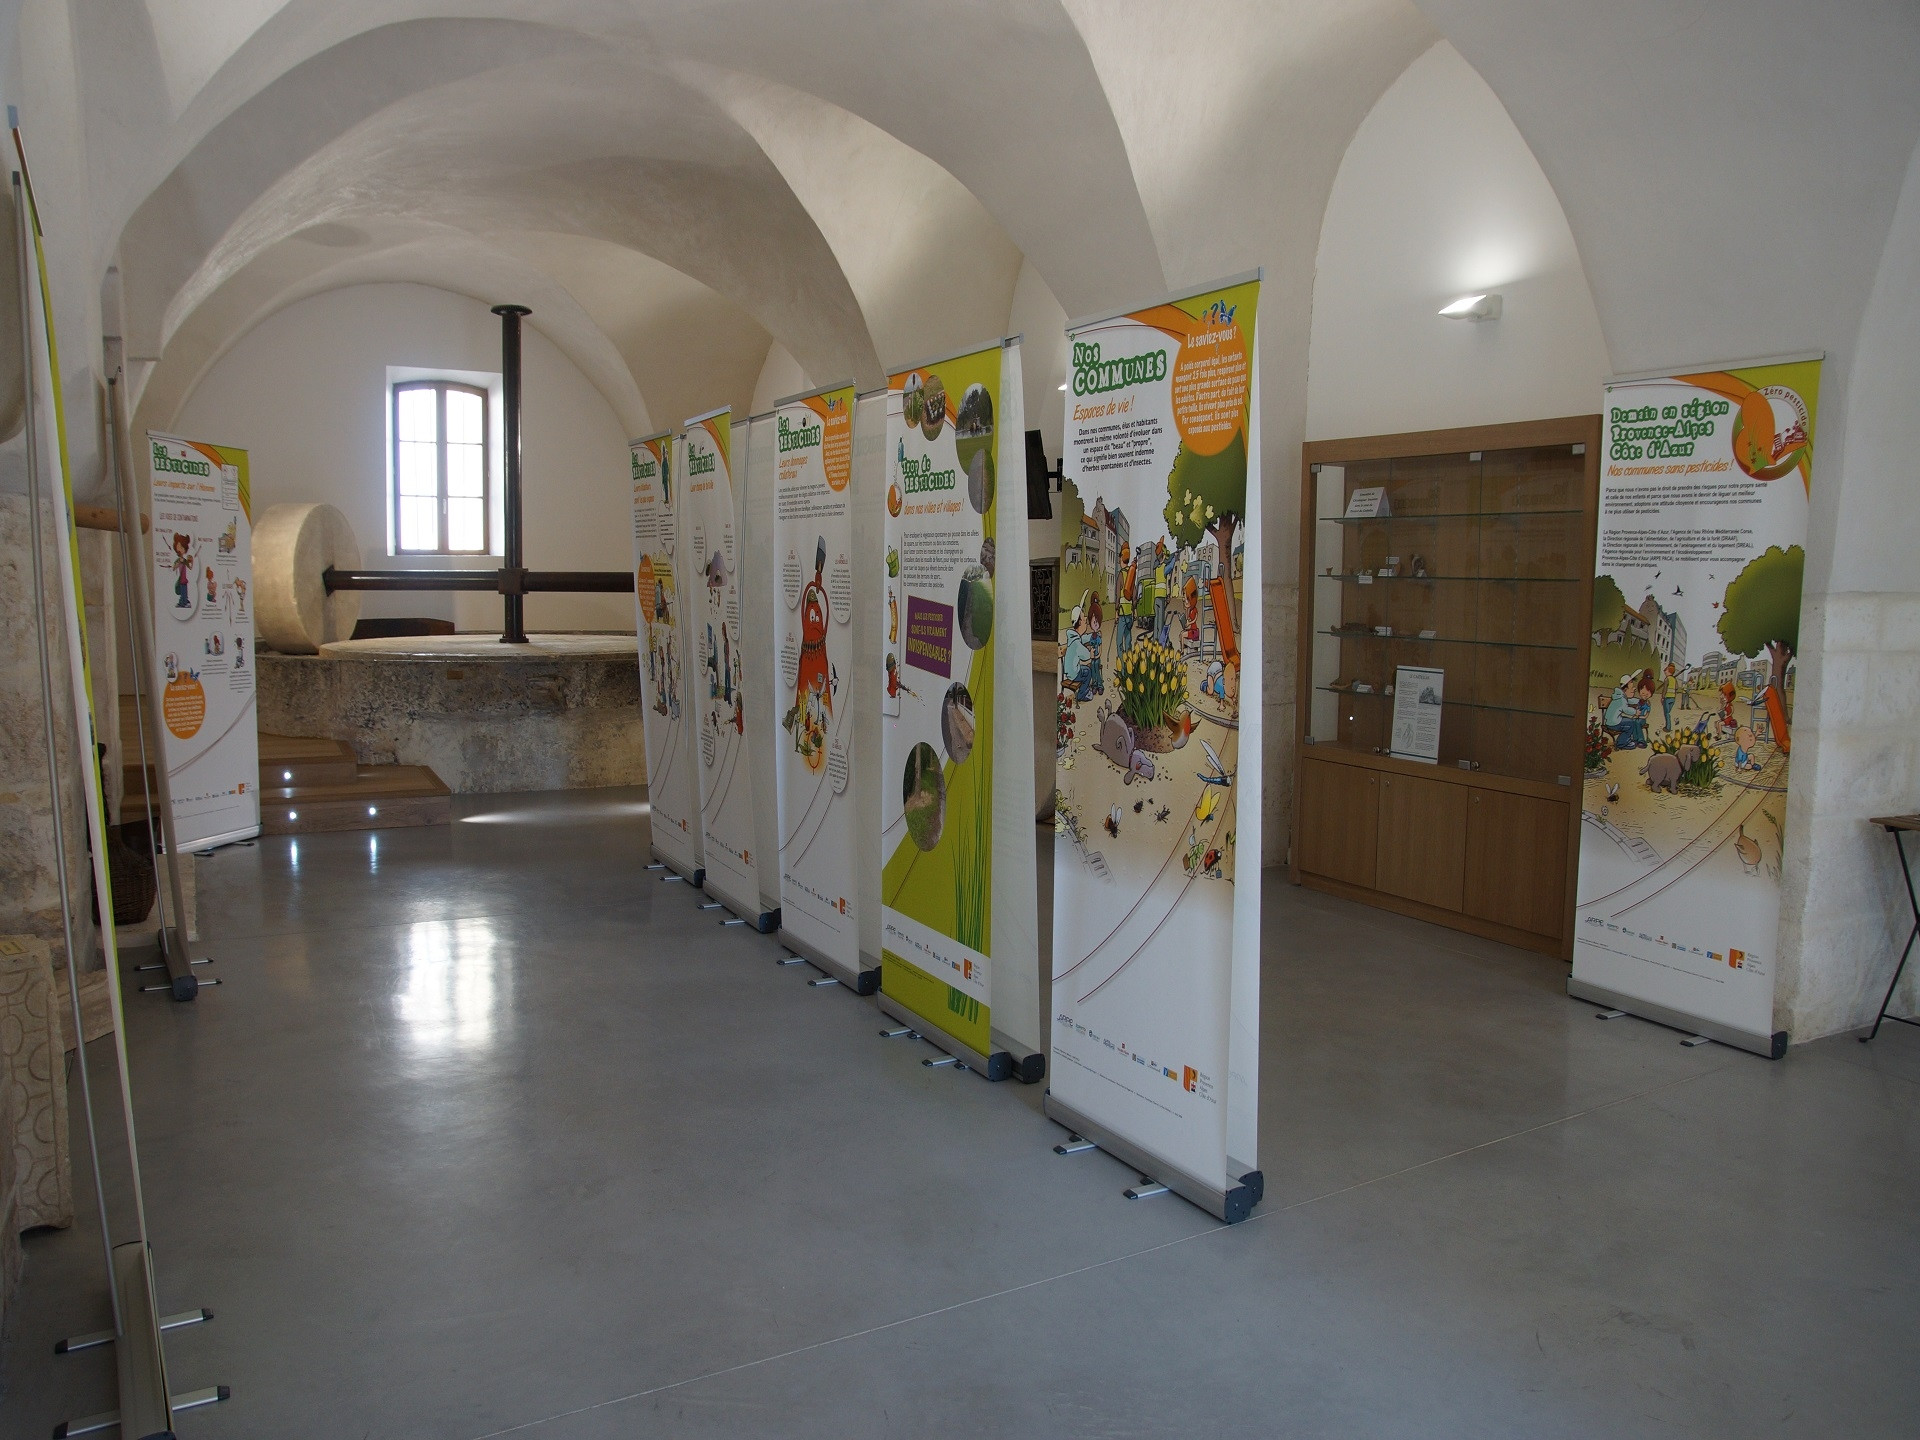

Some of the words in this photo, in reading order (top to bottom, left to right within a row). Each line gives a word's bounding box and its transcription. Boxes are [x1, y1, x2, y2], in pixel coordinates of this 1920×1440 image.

[1187, 333, 1194, 348] Le
[1195, 329, 1232, 346] saviez-vous
[1073, 341, 1099, 365] Nos
[1073, 351, 1165, 394] COMMUNES
[1073, 403, 1107, 423] Espaces
[1108, 398, 1117, 416] de
[1118, 398, 1129, 413] vie
[1130, 395, 1135, 411] !
[1611, 406, 1656, 422] Demain
[1662, 406, 1677, 418] en
[1682, 398, 1728, 419] région
[1763, 386, 1782, 395] Zéro
[1783, 391, 1807, 426] pesticide
[778, 415, 788, 432] Les
[1611, 421, 1713, 441] Provence-Alpes
[153, 442, 167, 456] Les
[779, 425, 820, 452] PESTICIDES
[1611, 442, 1642, 460] Côte
[1648, 440, 1693, 458] d'Azur
[154, 455, 209, 477] PESTICIDES
[901, 456, 918, 476] Trop
[921, 454, 930, 472] de
[1607, 465, 1622, 476] Nos
[1624, 464, 1664, 476] communes
[1666, 463, 1684, 474] sans
[1685, 460, 1728, 475] pesticides
[904, 470, 954, 492] PESTICIDES
